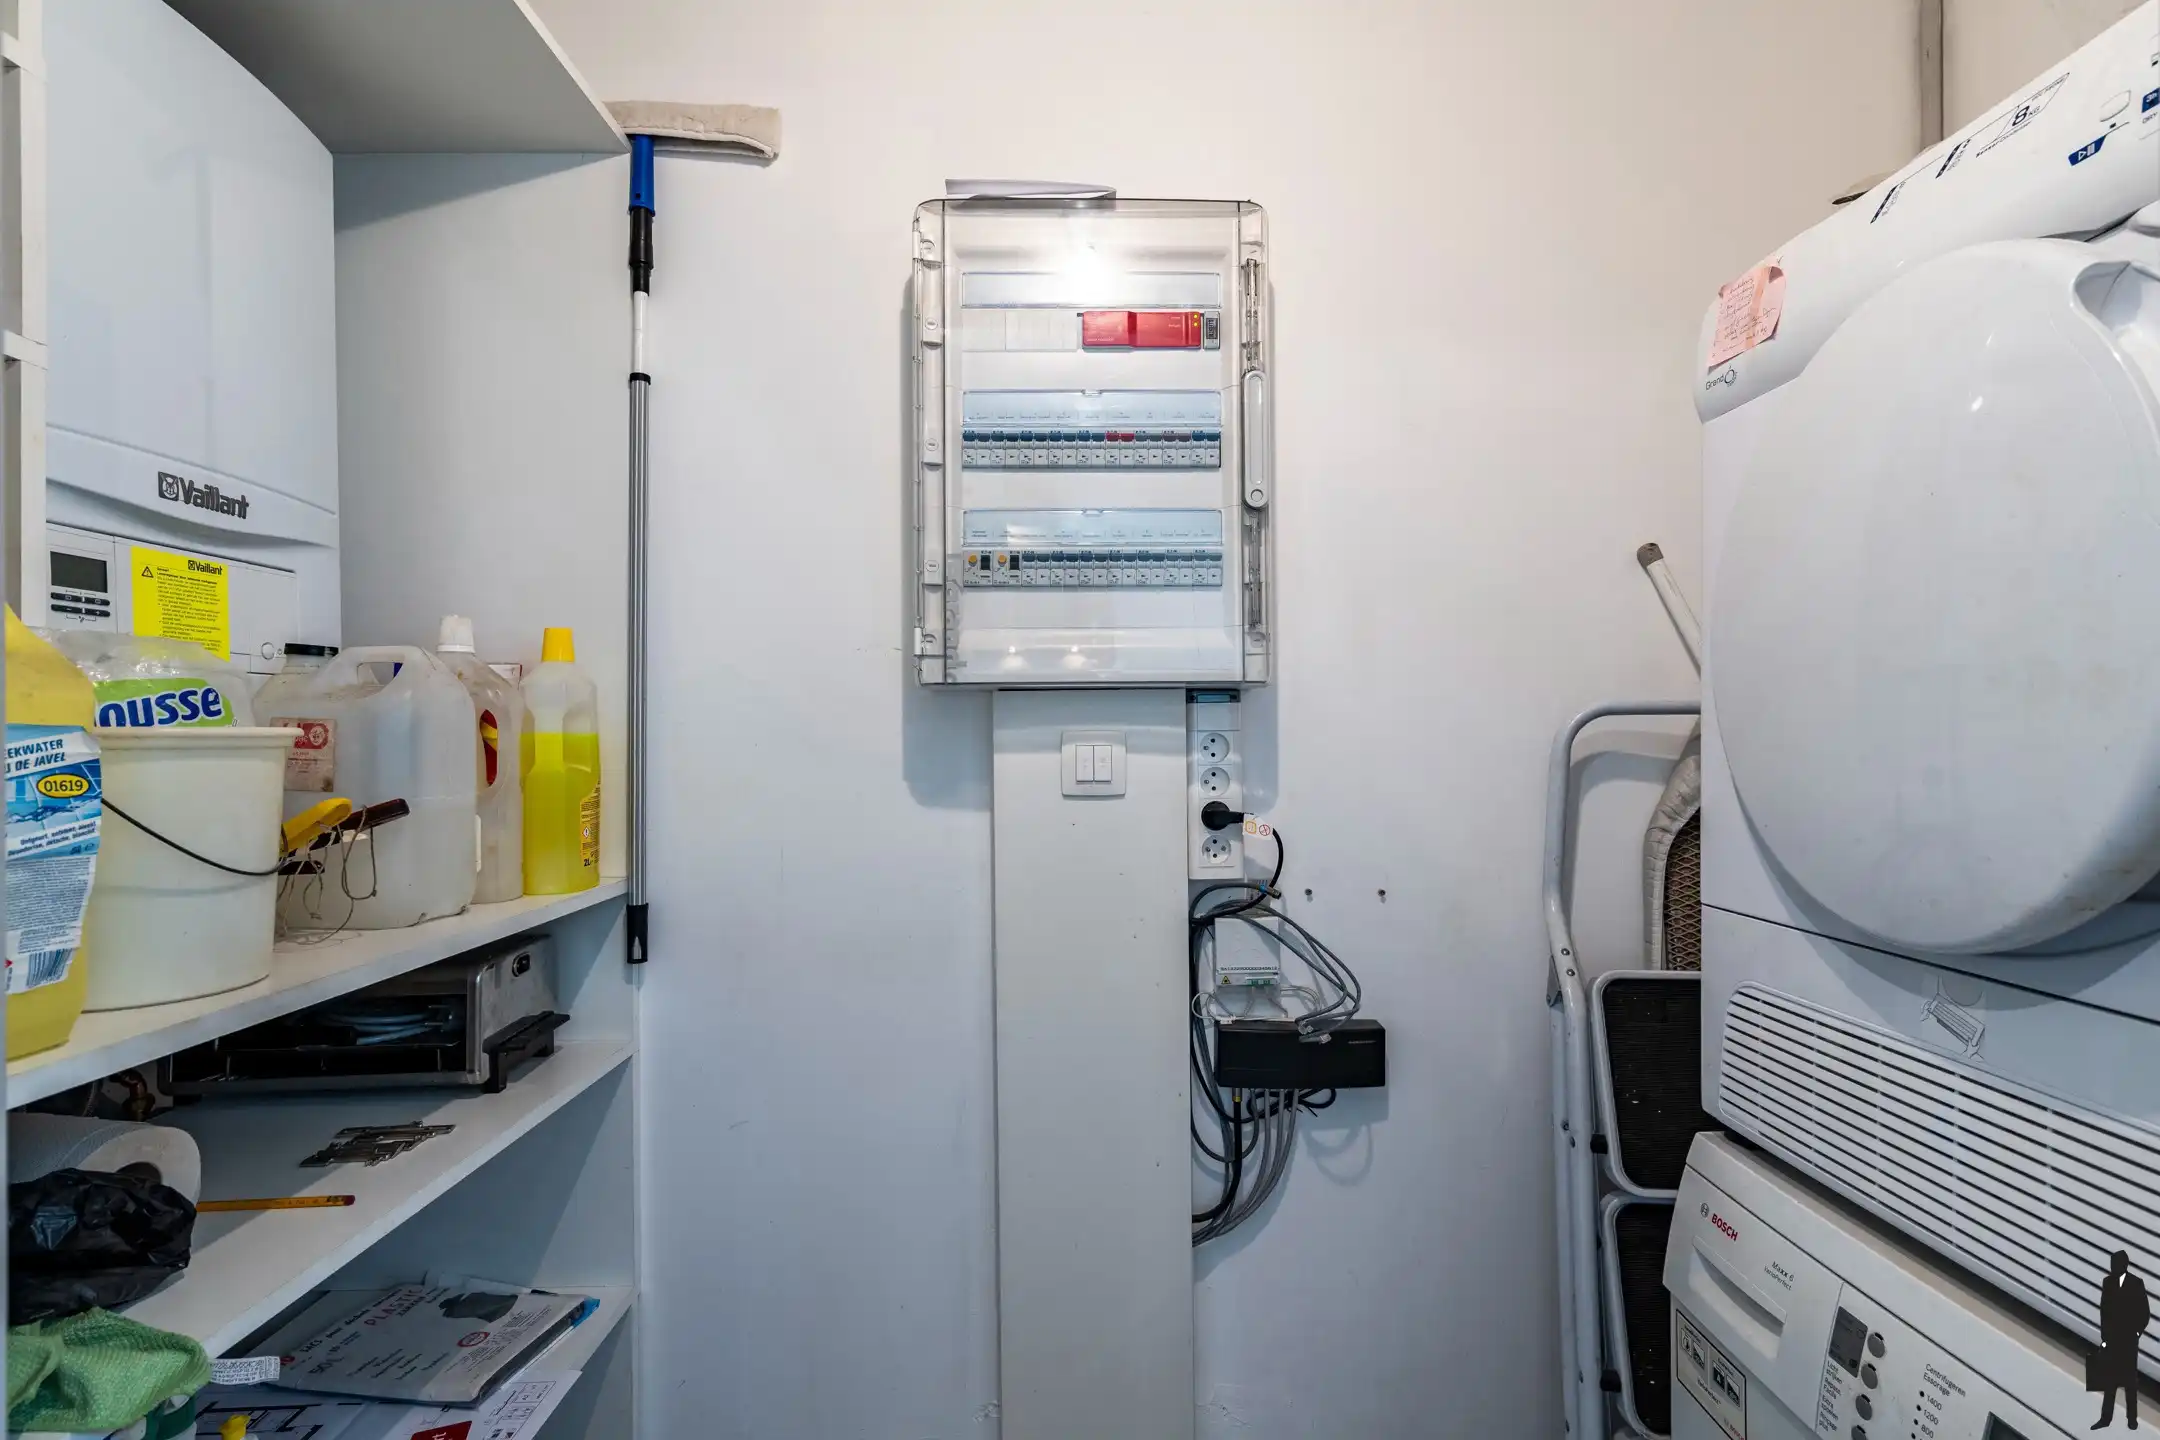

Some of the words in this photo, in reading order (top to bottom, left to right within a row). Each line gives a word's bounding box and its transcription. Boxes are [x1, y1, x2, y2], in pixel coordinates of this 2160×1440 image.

[2012, 105, 2030, 127] 8
[179, 477, 249, 520] Vaillant
[195, 561, 222, 576] Vaillant
[94, 686, 223, 727] ousse
[4, 739, 64, 759] EKWATER
[43, 780, 84, 792] 01619
[1711, 1212, 1739, 1242] BOSCH
[1771, 1260, 1789, 1279] Maxx
[1923, 1371, 1951, 1397] Essorage
[1925, 1363, 1967, 1398] Centrifugeren
[1926, 1394, 1943, 1411] 1400
[1923, 1409, 1940, 1426] 1200
[1920, 1423, 1934, 1439] 800
